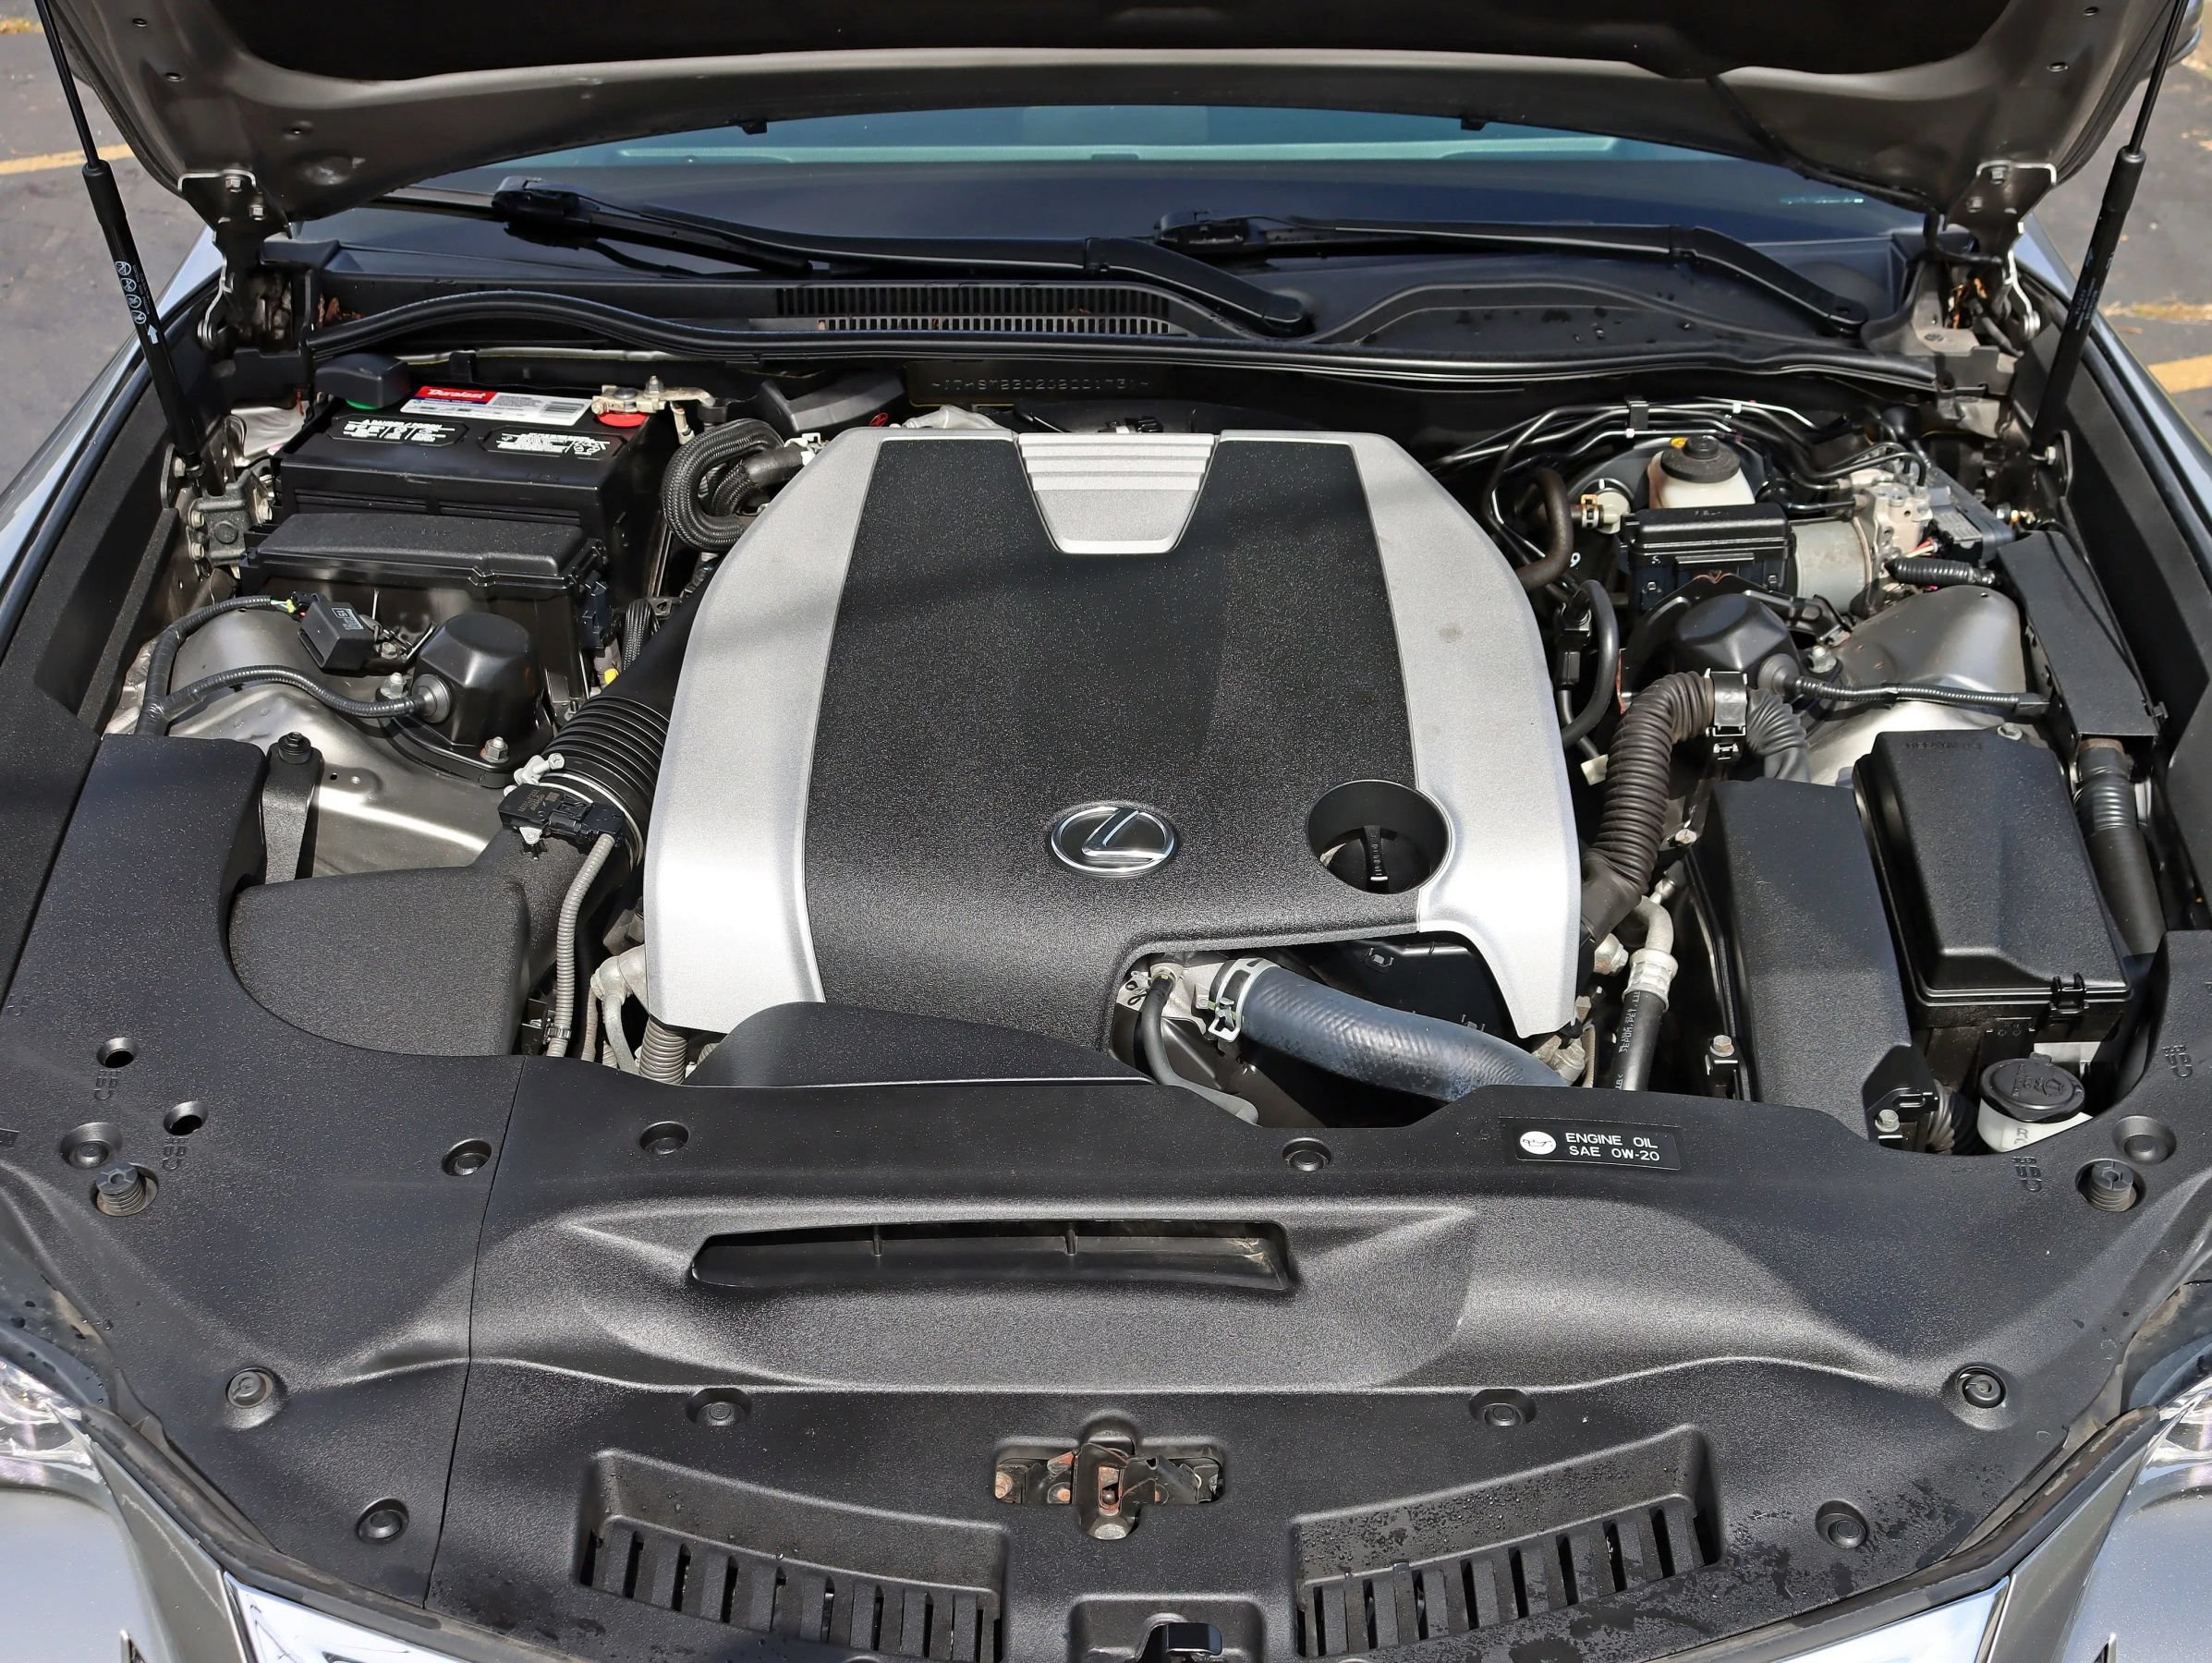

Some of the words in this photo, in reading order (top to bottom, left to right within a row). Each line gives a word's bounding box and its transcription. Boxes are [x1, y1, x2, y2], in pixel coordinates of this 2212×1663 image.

[428, 389, 486, 399] Duralast
[1565, 1132, 1623, 1146] ENGINE
[1634, 1136, 1659, 1149] OIL
[1569, 1146, 1601, 1158] SAE
[1611, 1147, 1660, 1161] 0W-20
